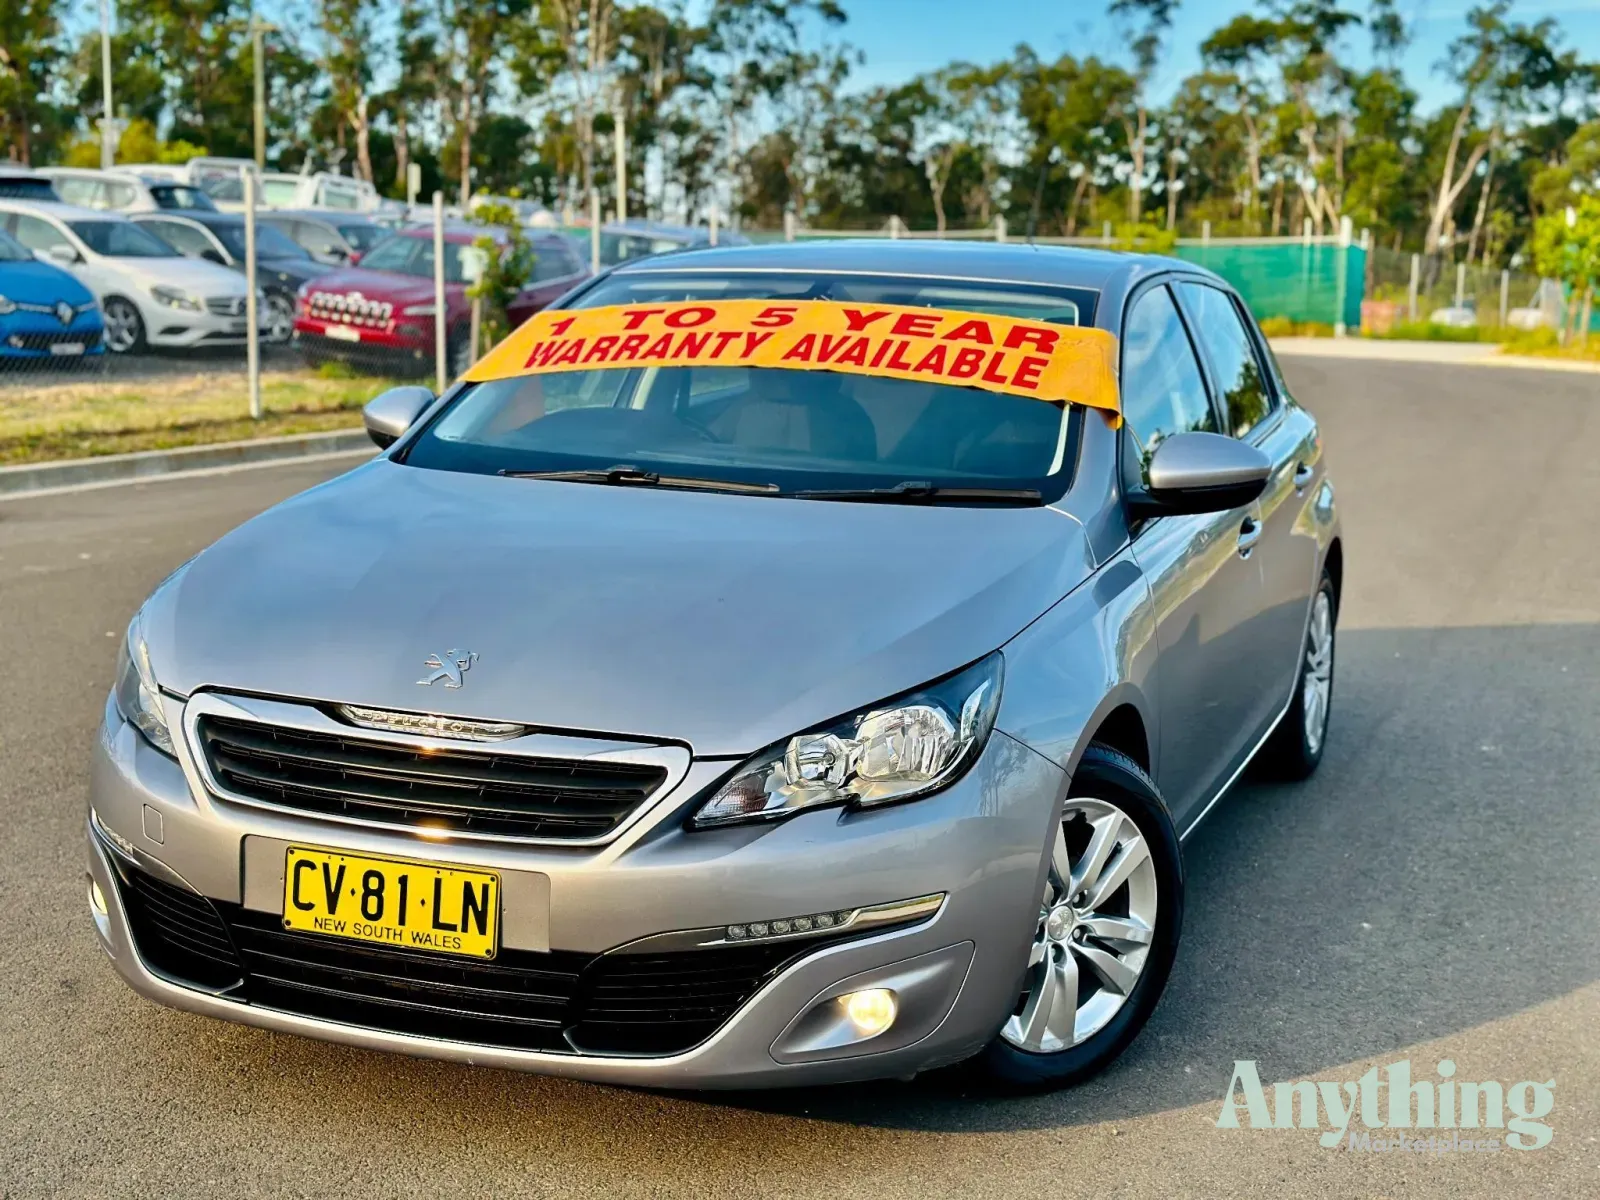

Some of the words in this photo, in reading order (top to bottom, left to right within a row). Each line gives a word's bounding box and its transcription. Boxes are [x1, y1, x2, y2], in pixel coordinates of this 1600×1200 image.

[549, 318, 577, 336] 1
[623, 308, 716, 331] TO
[751, 307, 798, 328] 5
[843, 309, 1061, 355] YEAR
[524, 332, 774, 369] WARRANTY
[781, 333, 1050, 390] AVAILABLE
[314, 916, 346, 933] NEW
[352, 922, 404, 942] SOUTH
[411, 931, 462, 950] WALES
